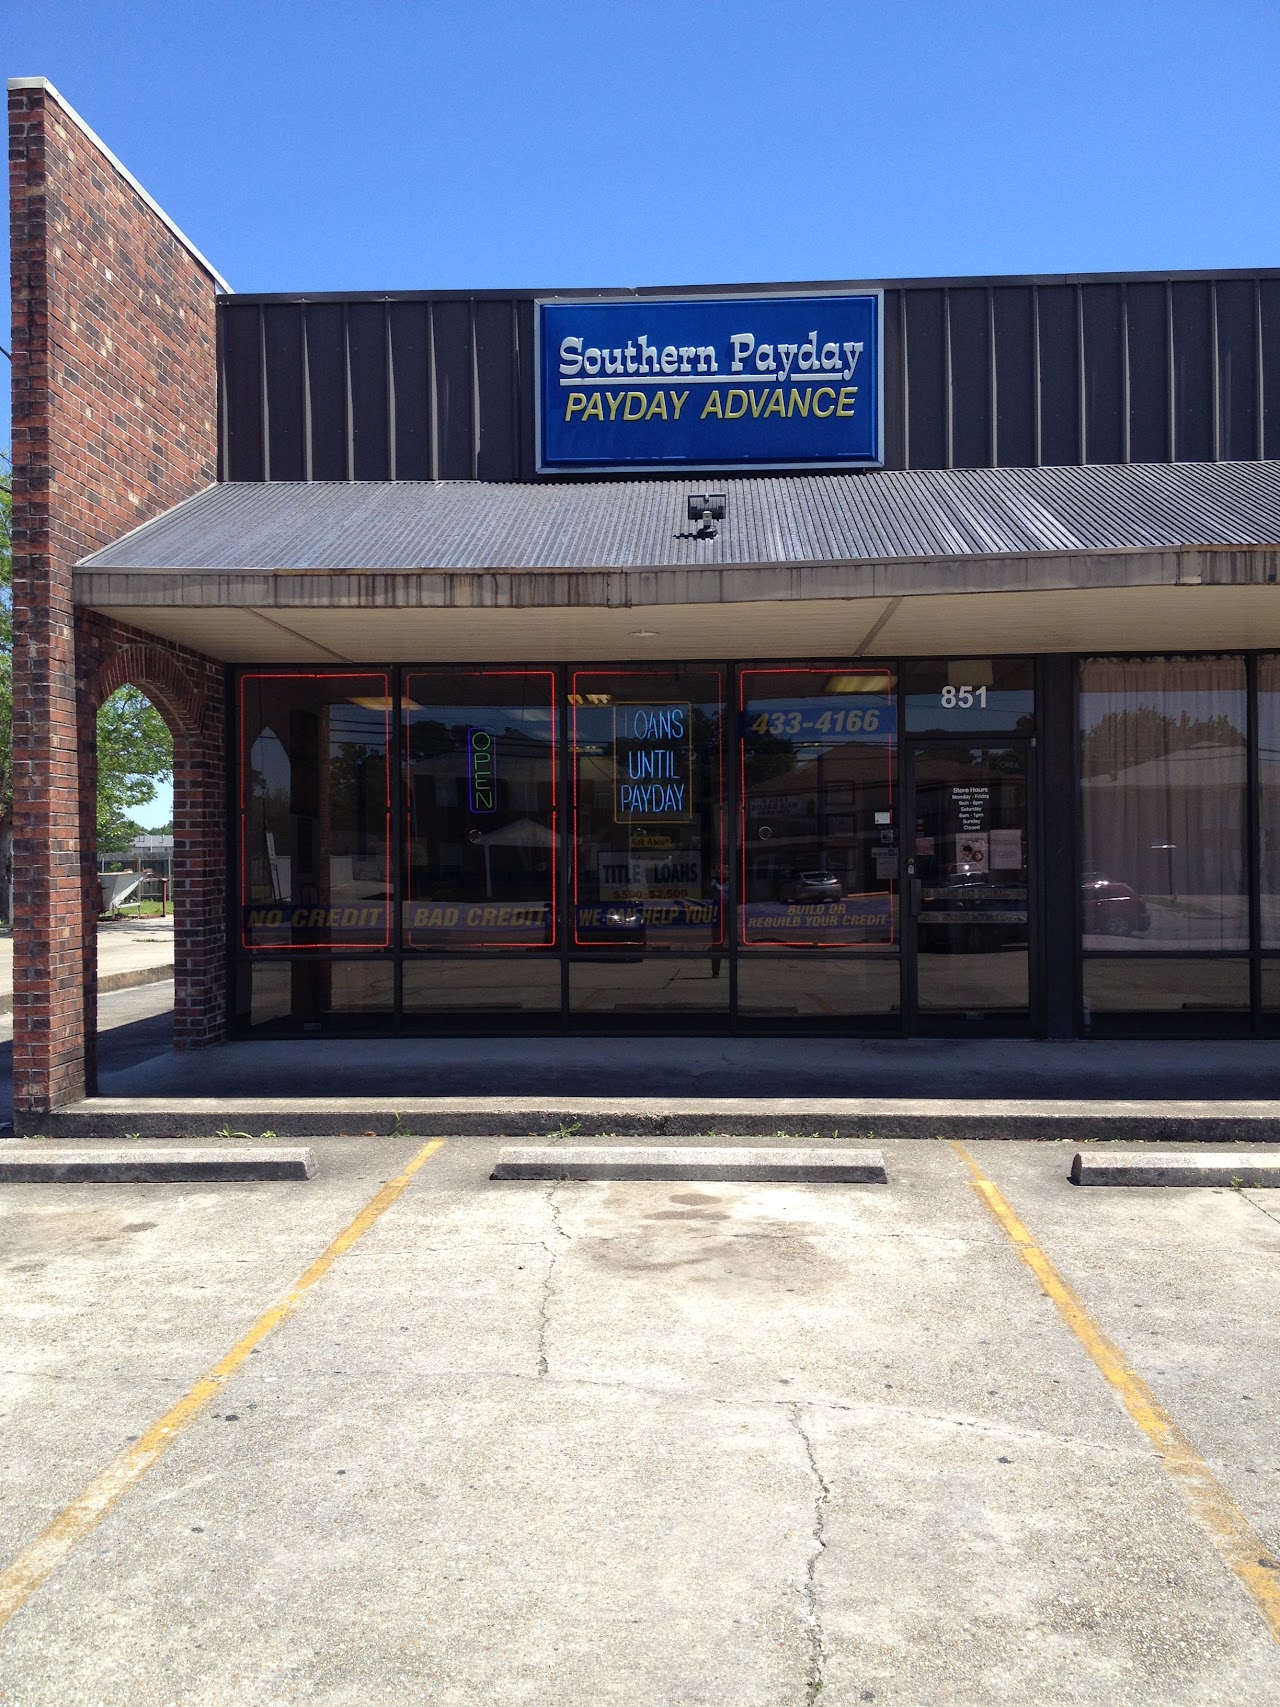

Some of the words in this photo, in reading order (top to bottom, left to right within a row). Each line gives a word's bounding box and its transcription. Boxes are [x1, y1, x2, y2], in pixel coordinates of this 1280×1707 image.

[559, 335, 718, 375] Southern
[730, 331, 864, 382] Payday
[564, 391, 690, 422] PAYDAY
[700, 387, 858, 419] ADVANCE
[941, 685, 988, 709] 851
[624, 709, 684, 739] LOANS
[751, 709, 881, 735] 433-4166
[471, 731, 493, 810] OPEN
[628, 750, 681, 779] UNTIL
[620, 783, 685, 813] PAYDAY
[603, 864, 641, 884] TITLE
[654, 862, 697, 883] LOANS
[247, 909, 282, 928] NO
[292, 907, 386, 928] CREDIT
[414, 908, 459, 928] BAD
[467, 907, 549, 927] CREDIT
[579, 908, 602, 926] WE
[643, 906, 680, 925] HELP
[684, 904, 718, 924] YOU!
[747, 916, 802, 928] REBUILD
[805, 915, 839, 927] YOUR
[842, 914, 889, 926] CREDIT
[788, 903, 826, 915] BUILD
[828, 903, 847, 915] OR
